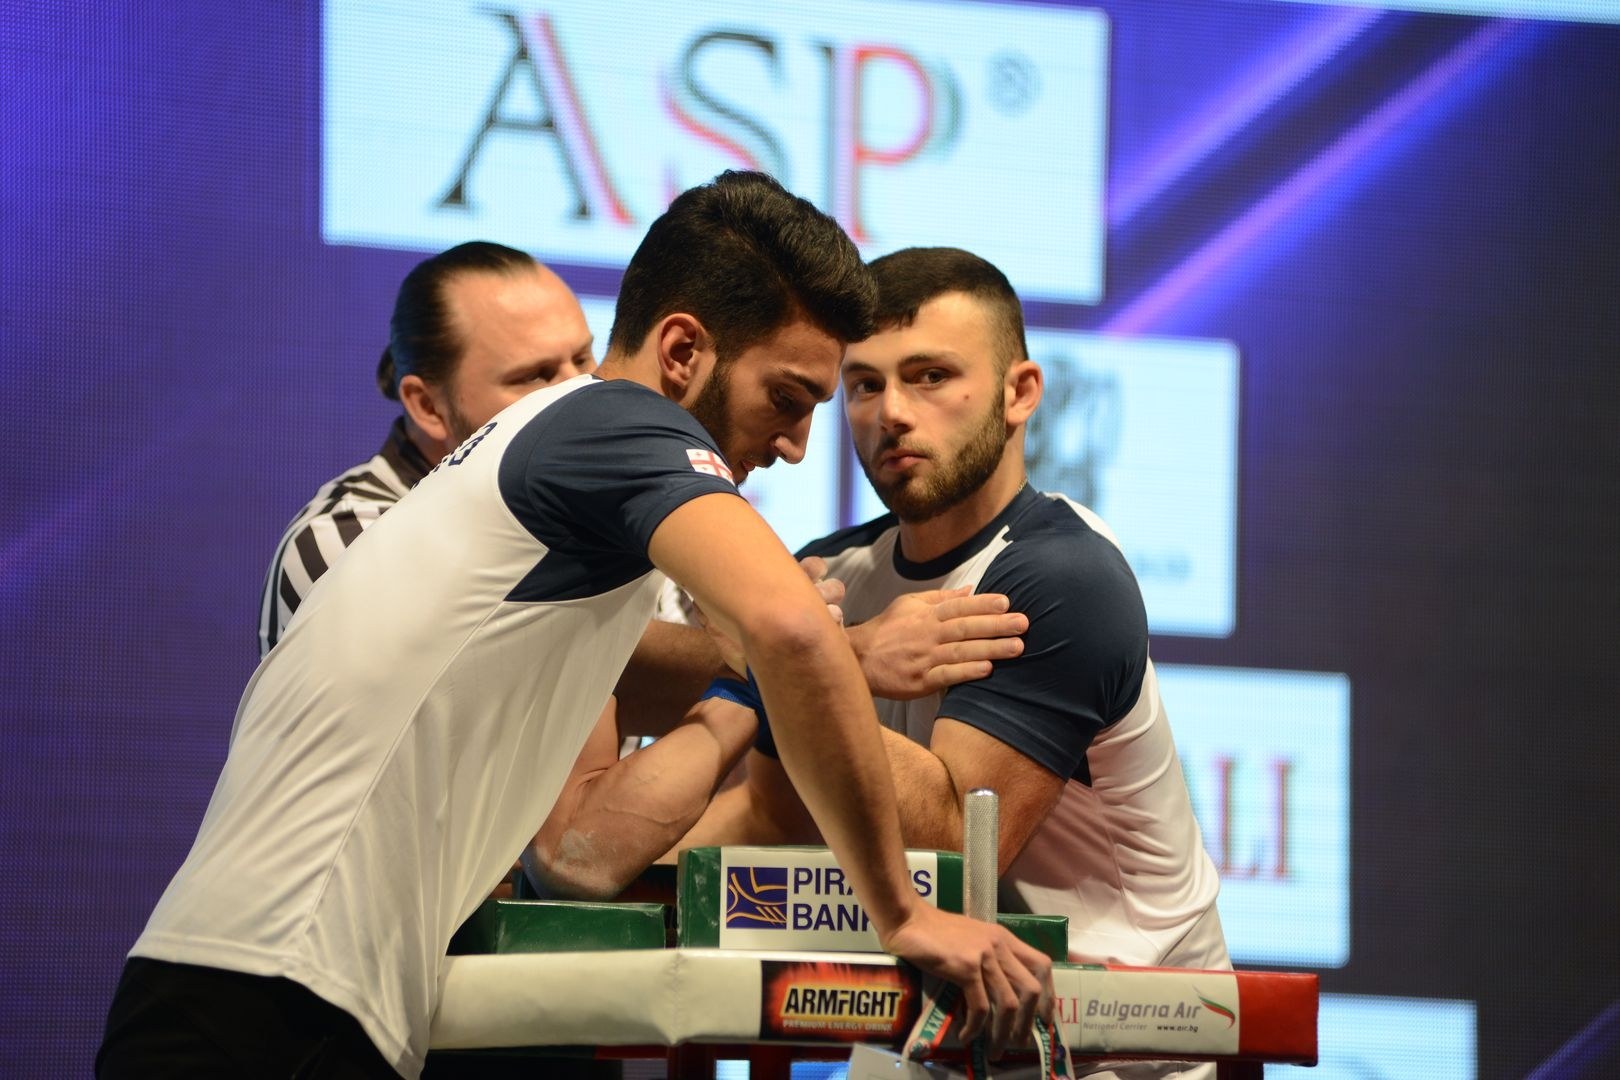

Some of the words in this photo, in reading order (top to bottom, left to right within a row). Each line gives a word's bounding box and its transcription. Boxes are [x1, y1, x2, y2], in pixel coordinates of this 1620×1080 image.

[432, 4, 962, 245] ASP
[793, 867, 932, 897] PIRS
[784, 988, 899, 1018] ARMFIGHT
[1086, 999, 1170, 1021] Bulgaria
[1173, 1001, 1201, 1018] Air
[783, 1019, 826, 1029] PREMIUM
[828, 1021, 863, 1030] ENERGY
[864, 1022, 893, 1032] DRINK
[1157, 1024, 1199, 1034] www.air.bg
